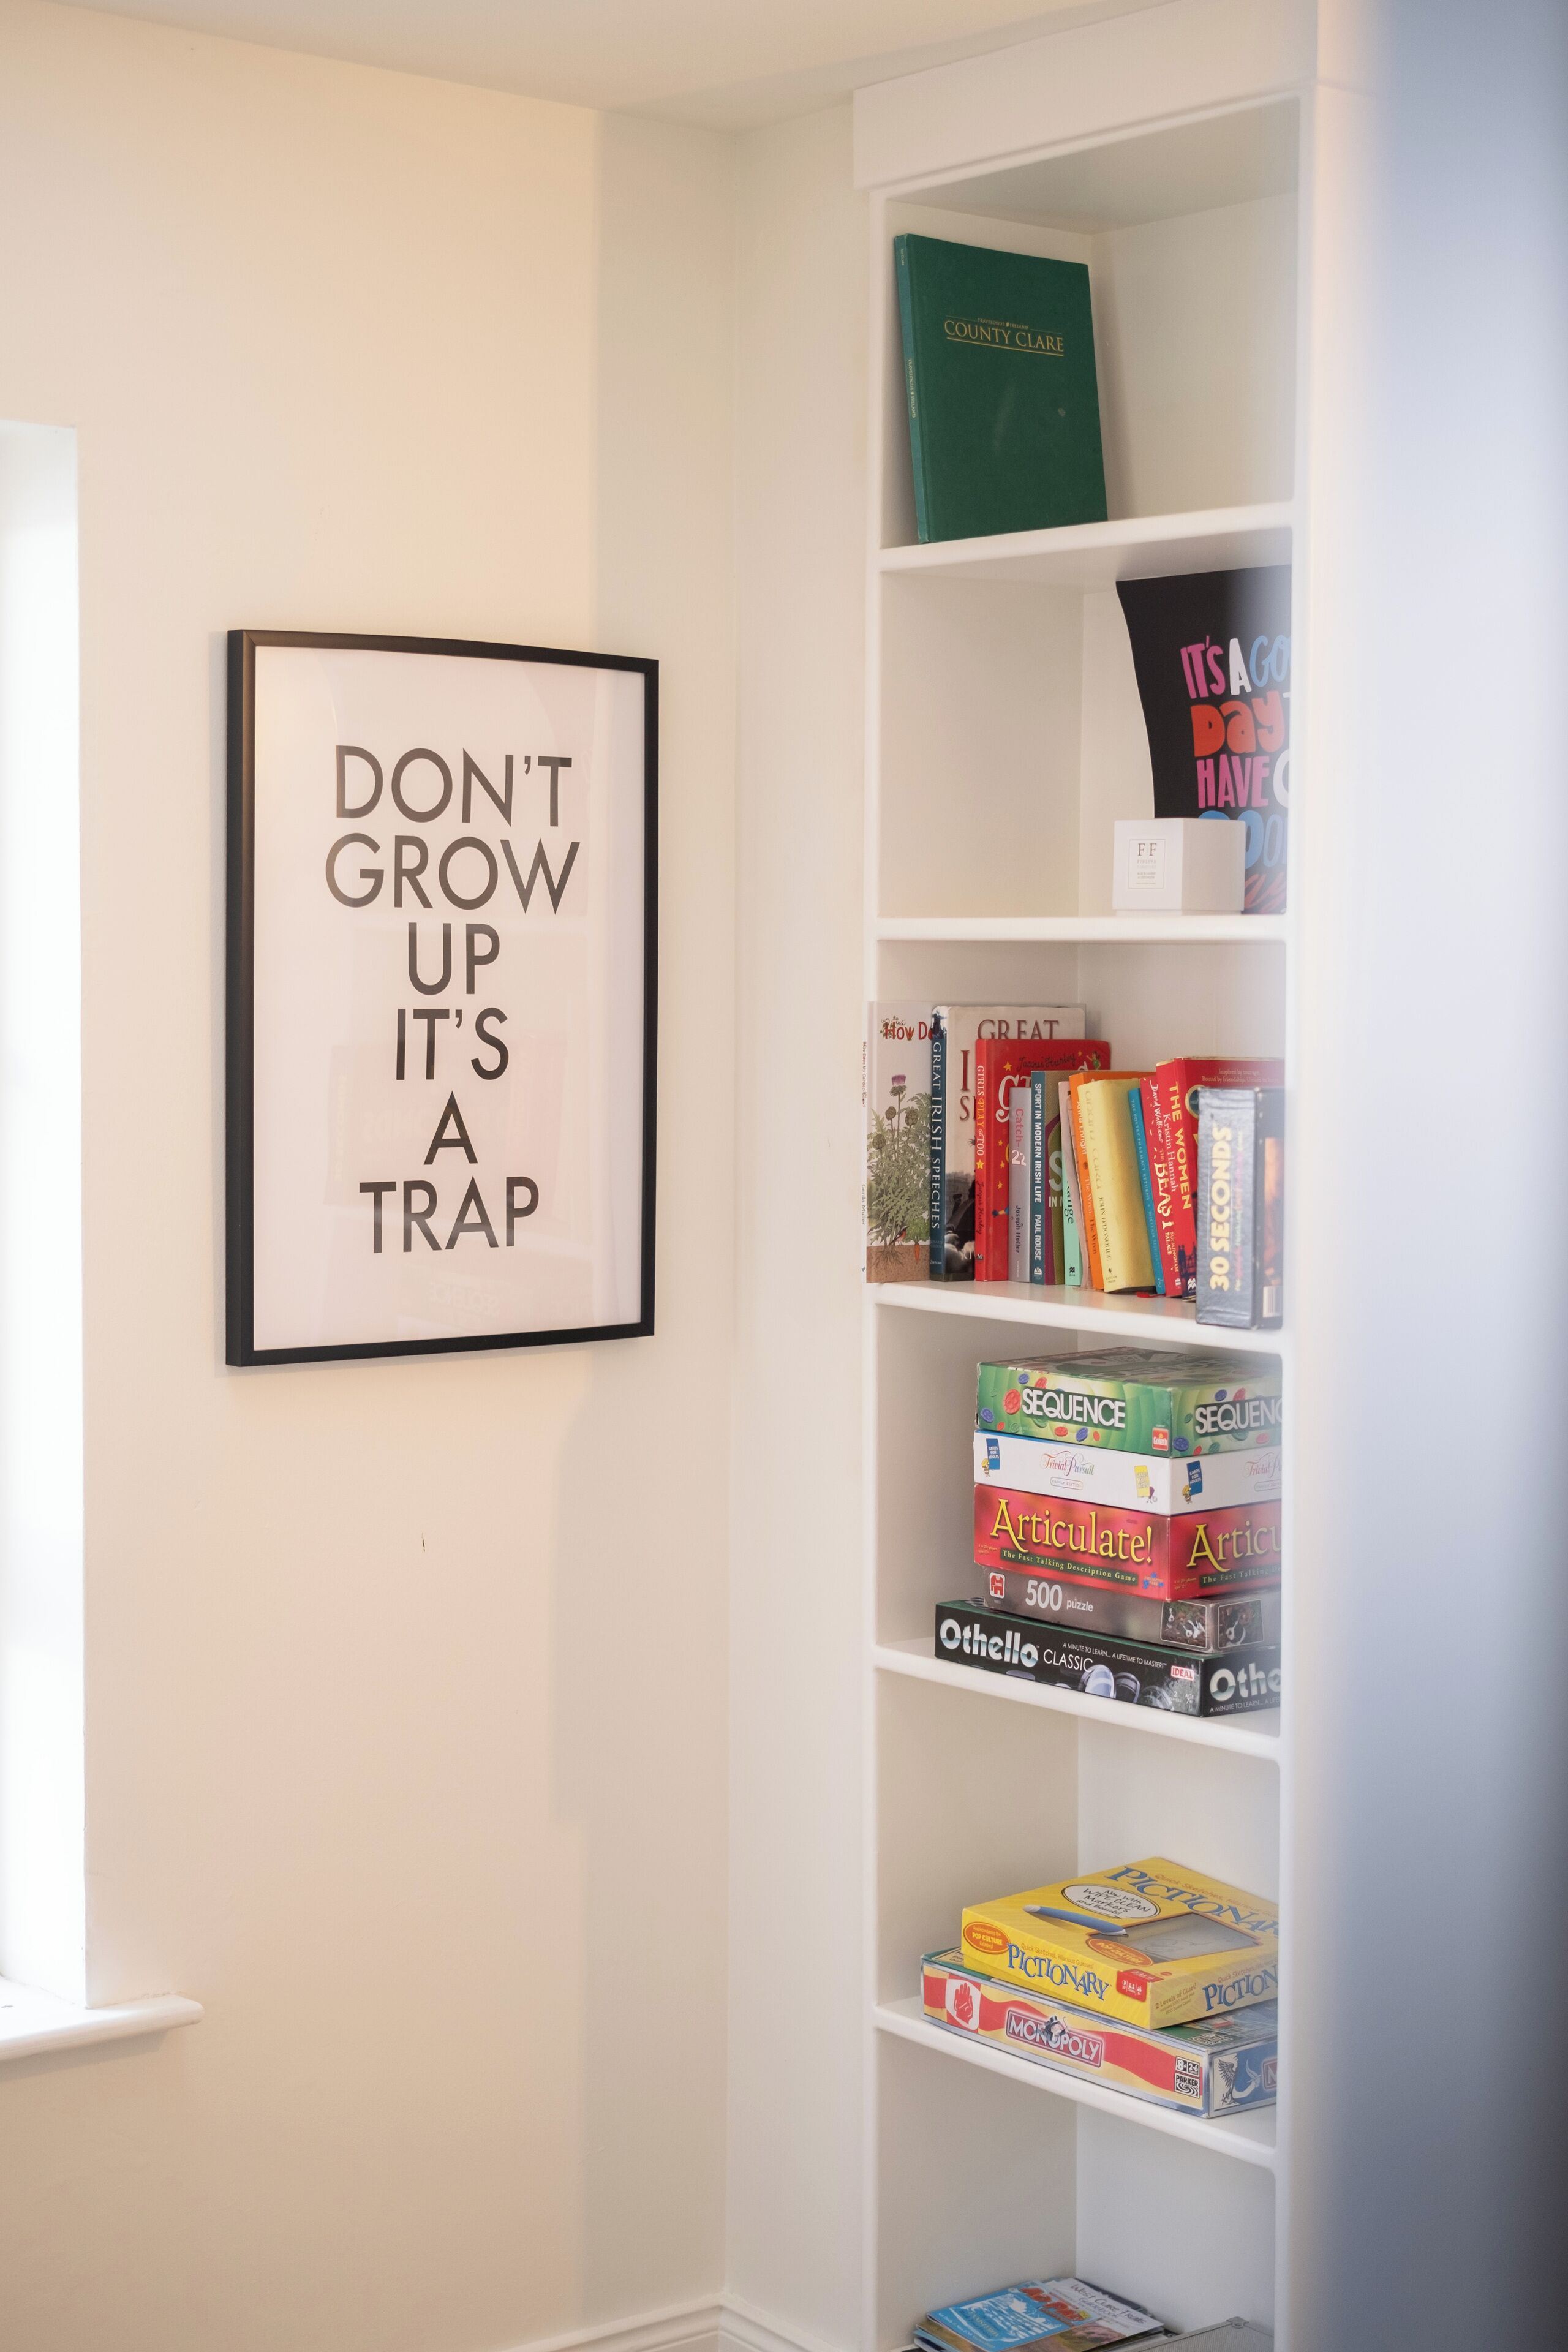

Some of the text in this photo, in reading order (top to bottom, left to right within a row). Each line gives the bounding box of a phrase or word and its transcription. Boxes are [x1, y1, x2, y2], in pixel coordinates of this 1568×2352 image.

[944, 320, 1064, 352] COUNTY CLARE
[1180, 635, 1291, 699] IT'S A GO
[1196, 754, 1270, 809] HAVE
[325, 832, 580, 915] GROW
[407, 922, 500, 996] UP
[977, 1019, 1059, 1039] GREAT
[932, 1042, 942, 1090] GREAT
[932, 1097, 943, 1150] IRISH
[976, 1065, 985, 1156] GIRLS PLAY TOO
[1035, 1110, 1041, 1120] IN
[1150, 1080, 1164, 1144] David Walliams
[423, 1090, 478, 1165] A
[1137, 1138, 1146, 1171] PHARMACY
[1163, 1113, 1178, 1193] Kristin Hannah
[1169, 1081, 1191, 1210] THE WOMEN
[931, 1158, 941, 1229] SPEECHES
[1154, 1162, 1174, 1231] BEAST
[1210, 1126, 1232, 1291] 30 SECONDS
[359, 1175, 539, 1254] TRAP
[1022, 1388, 1126, 1428] SEQUENCE
[1041, 1451, 1095, 1476] Trivial Pursuit
[1245, 1459, 1270, 1478] Trivial
[990, 1498, 1153, 1564] Articulate!
[1003, 1550, 1016, 1559] The
[1019, 1553, 1033, 1562] Fast
[1036, 1556, 1064, 1570] Talking
[1067, 1562, 1112, 1577] Description
[1115, 1572, 1136, 1582] Game
[1239, 1569, 1269, 1578] Talking
[1025, 1580, 1094, 1612] 500 puzzle
[940, 1618, 1039, 1668] Othello
[1068, 1643, 1084, 1652] MINUTE
[1117, 1654, 1136, 1663] LIFETIME
[1043, 1649, 1093, 1673] CLASSIC
[1172, 1667, 1193, 1679] IDEAL
[1215, 1703, 1234, 1713] MINUTE
[1155, 1874, 1180, 1886] Quick
[1083, 1888, 1152, 1913] WIPE CLEAN
[1084, 1894, 1131, 1913] Markers
[1093, 1904, 1123, 1915] Boards!
[1122, 1895, 1142, 1904] With
[982, 1934, 1003, 1946] CULTURE
[1021, 1942, 1094, 1969] Quick Sketches, Hilarious Guesses!
[1006, 1943, 1110, 2001] PICTIONARY
[1218, 1973, 1232, 1983] Quick
[1160, 1996, 1175, 2007] Levels
[1182, 1982, 1197, 1995] Clues!
[1176, 2075, 1199, 2087] PARKER
[1177, 2059, 1187, 2071] 8+
[1070, 2283, 1096, 2301] West
[1094, 2296, 1120, 2313] Clare
